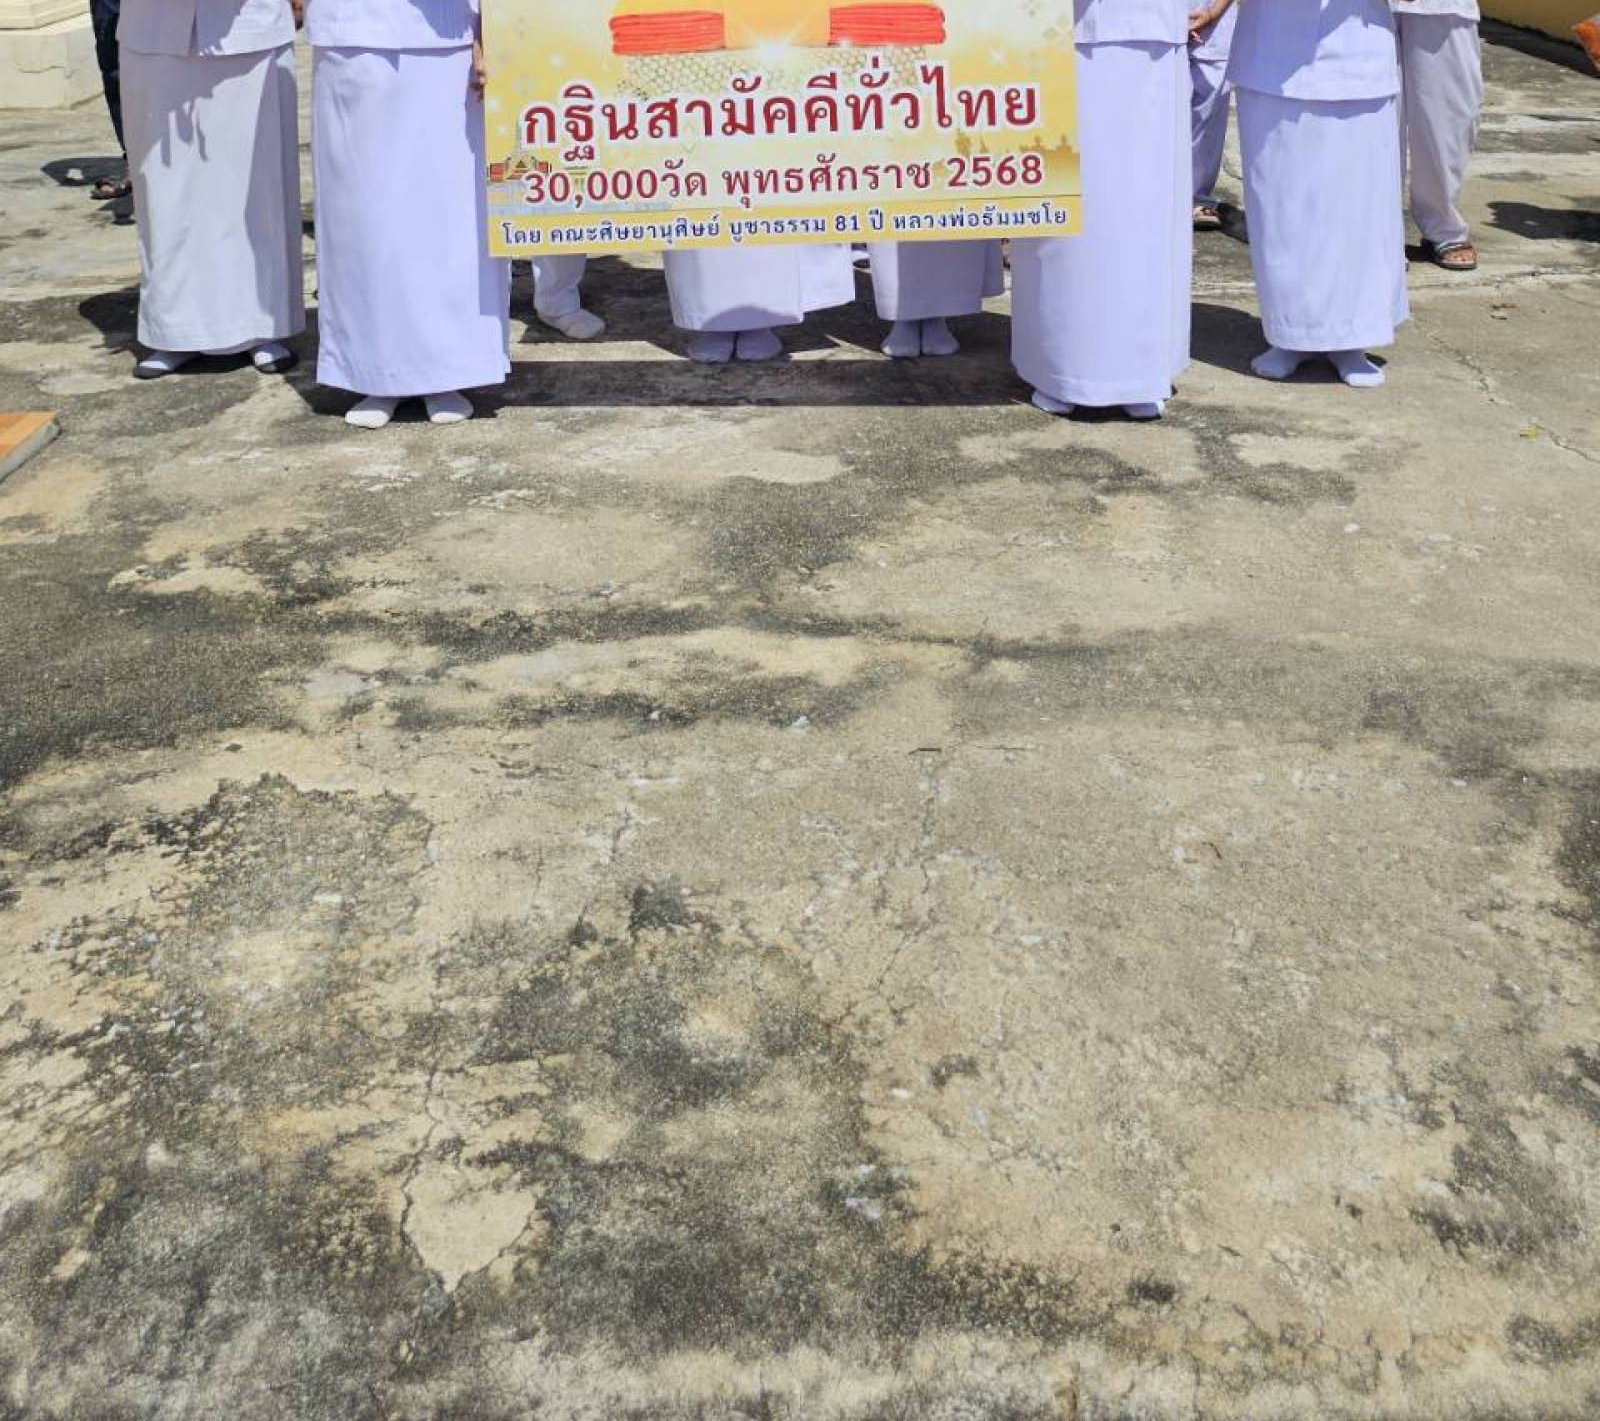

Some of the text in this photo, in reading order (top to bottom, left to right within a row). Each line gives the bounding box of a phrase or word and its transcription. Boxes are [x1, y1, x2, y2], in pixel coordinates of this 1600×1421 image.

[525, 57, 1037, 160] กฐินสามัคคีทั่วไทย
[525, 154, 1043, 208] 30,000วัด พุทธศักราช 2568
[502, 203, 1067, 244] โดย คณะศิษยานุศิษย์ บูชาธรรม 81 ปี หลวงพ่อธัมมชโย
